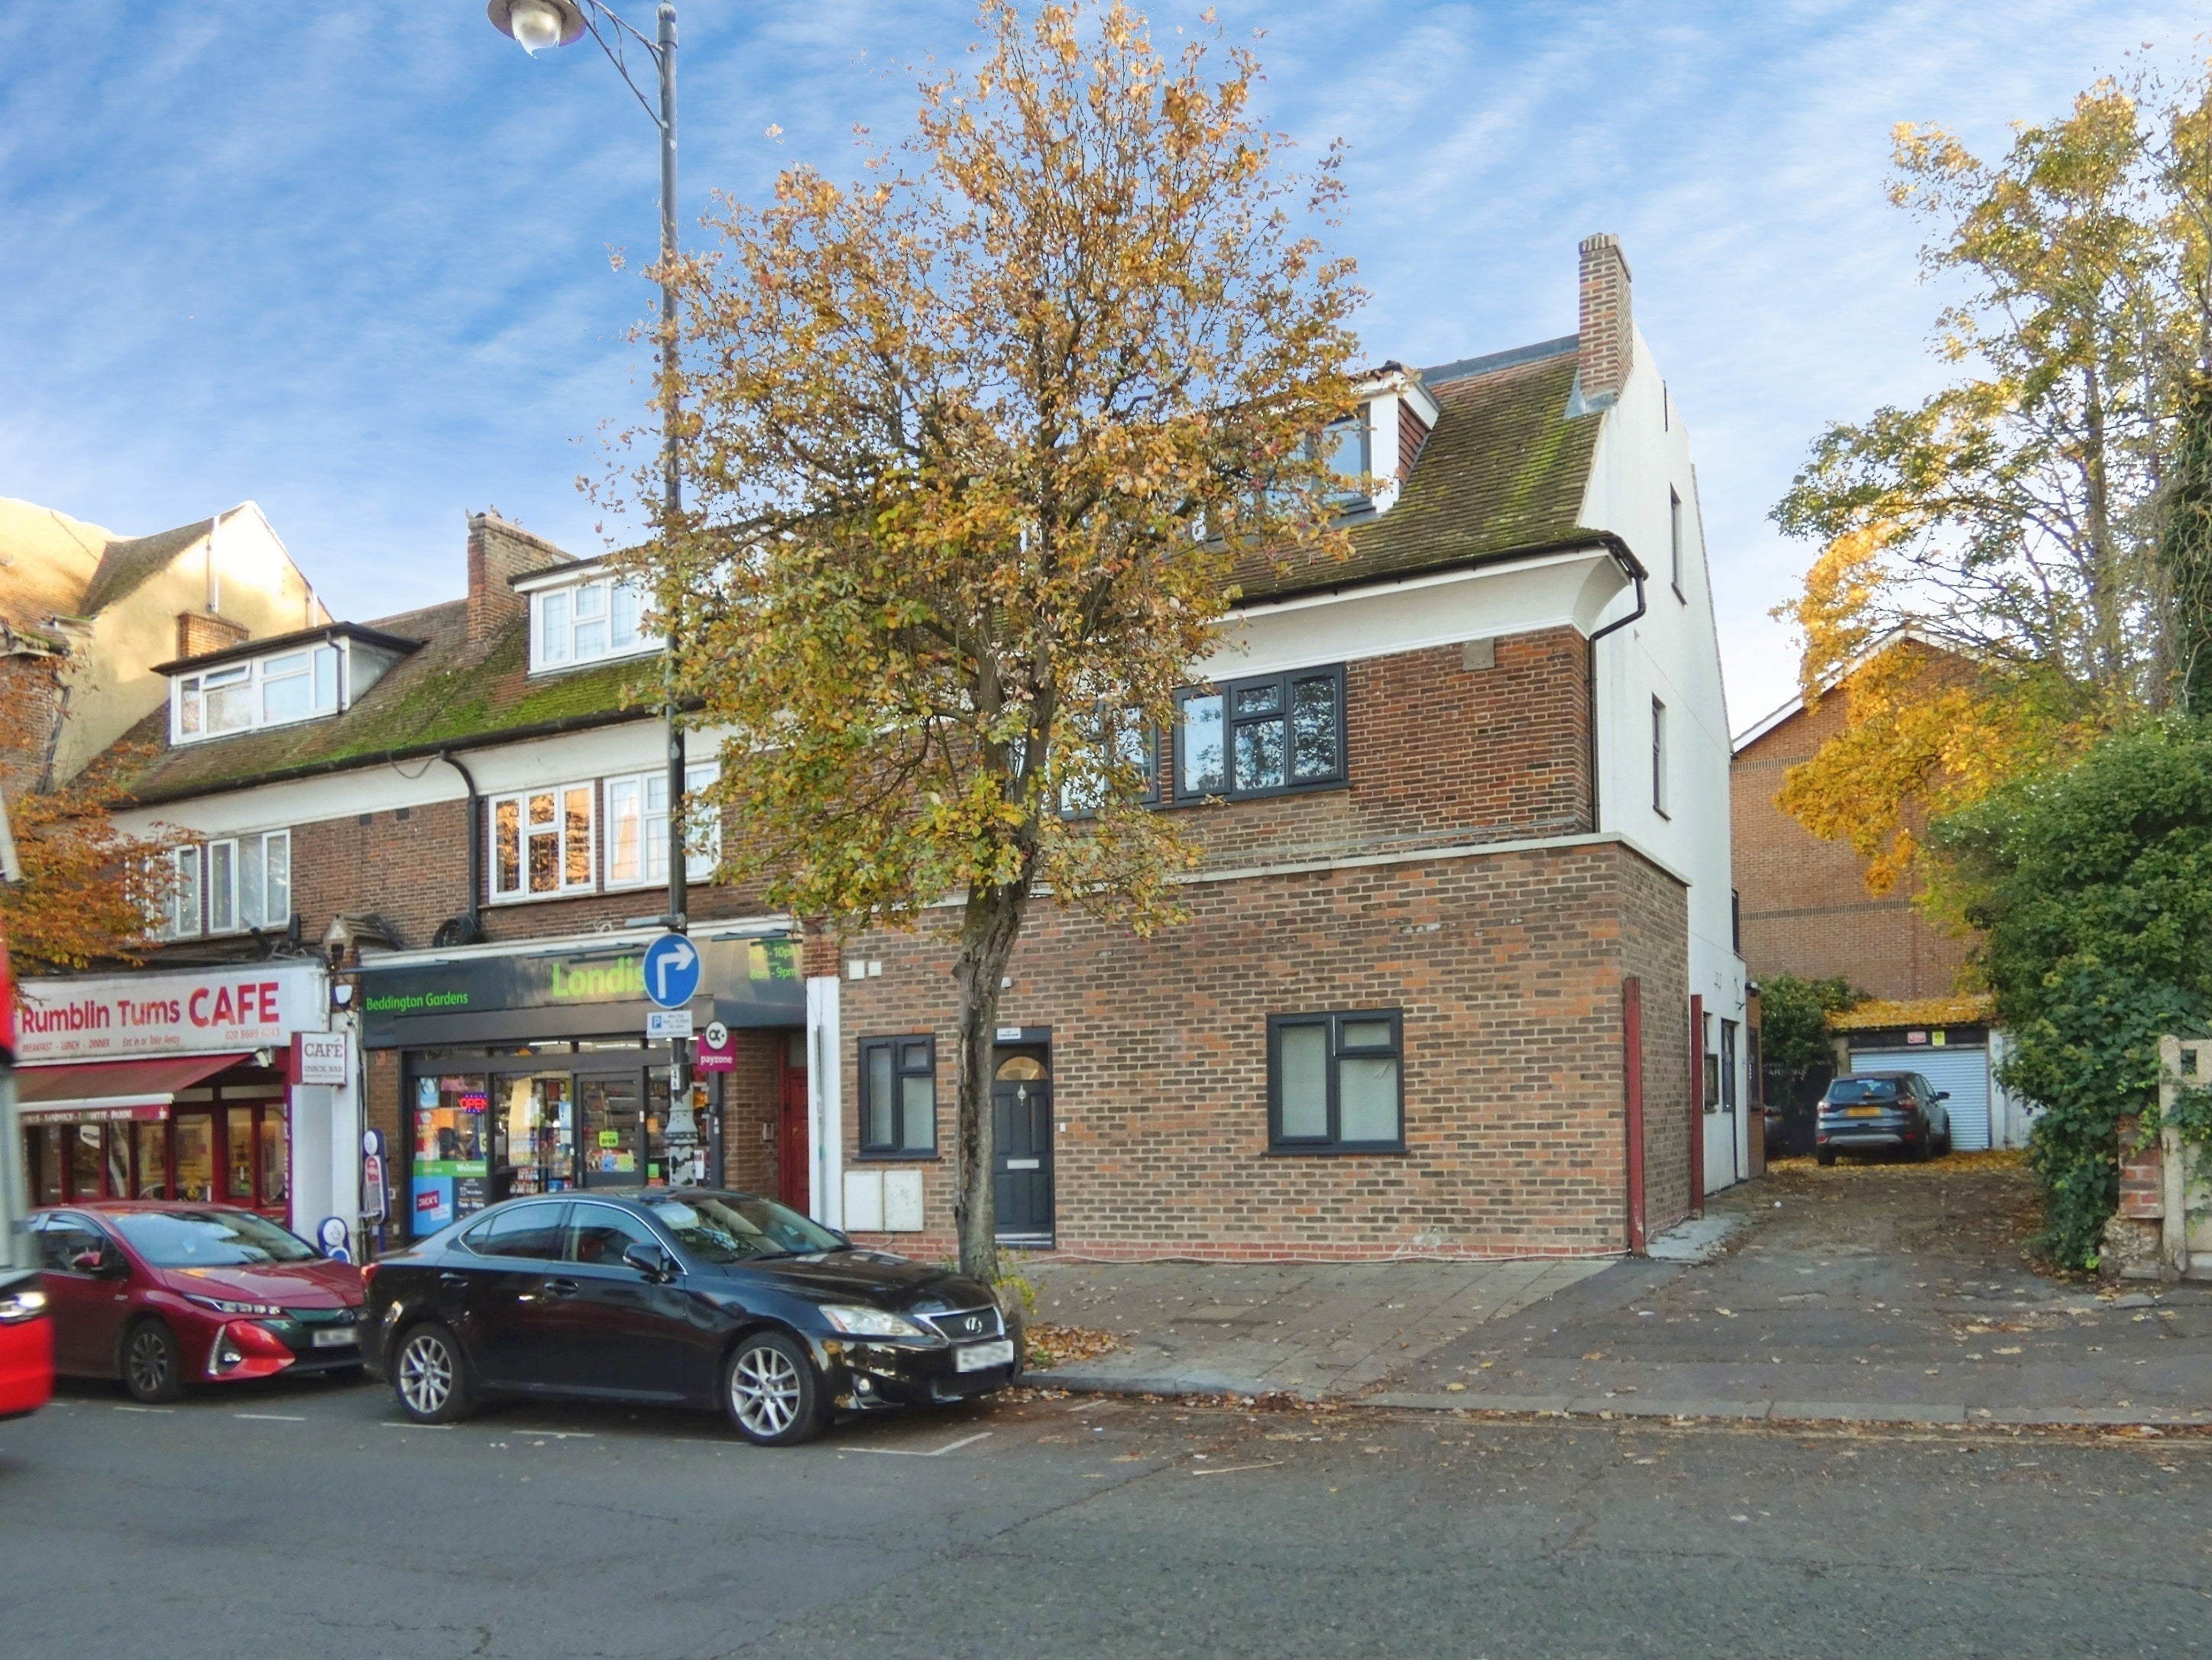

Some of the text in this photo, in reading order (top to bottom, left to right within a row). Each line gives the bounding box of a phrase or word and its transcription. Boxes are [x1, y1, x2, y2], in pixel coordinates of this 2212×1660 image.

[552, 956, 646, 997] Londis
[776, 967, 798, 979] 9pm
[21, 982, 280, 1034] Rumblin Tums CAFE
[366, 992, 468, 1011] Beddington Gardens
[89, 1038, 110, 1049] DINNER
[304, 1039, 343, 1058] CAFÉ
[701, 1056, 733, 1066] payzone
[459, 1099, 488, 1110] OPEN
